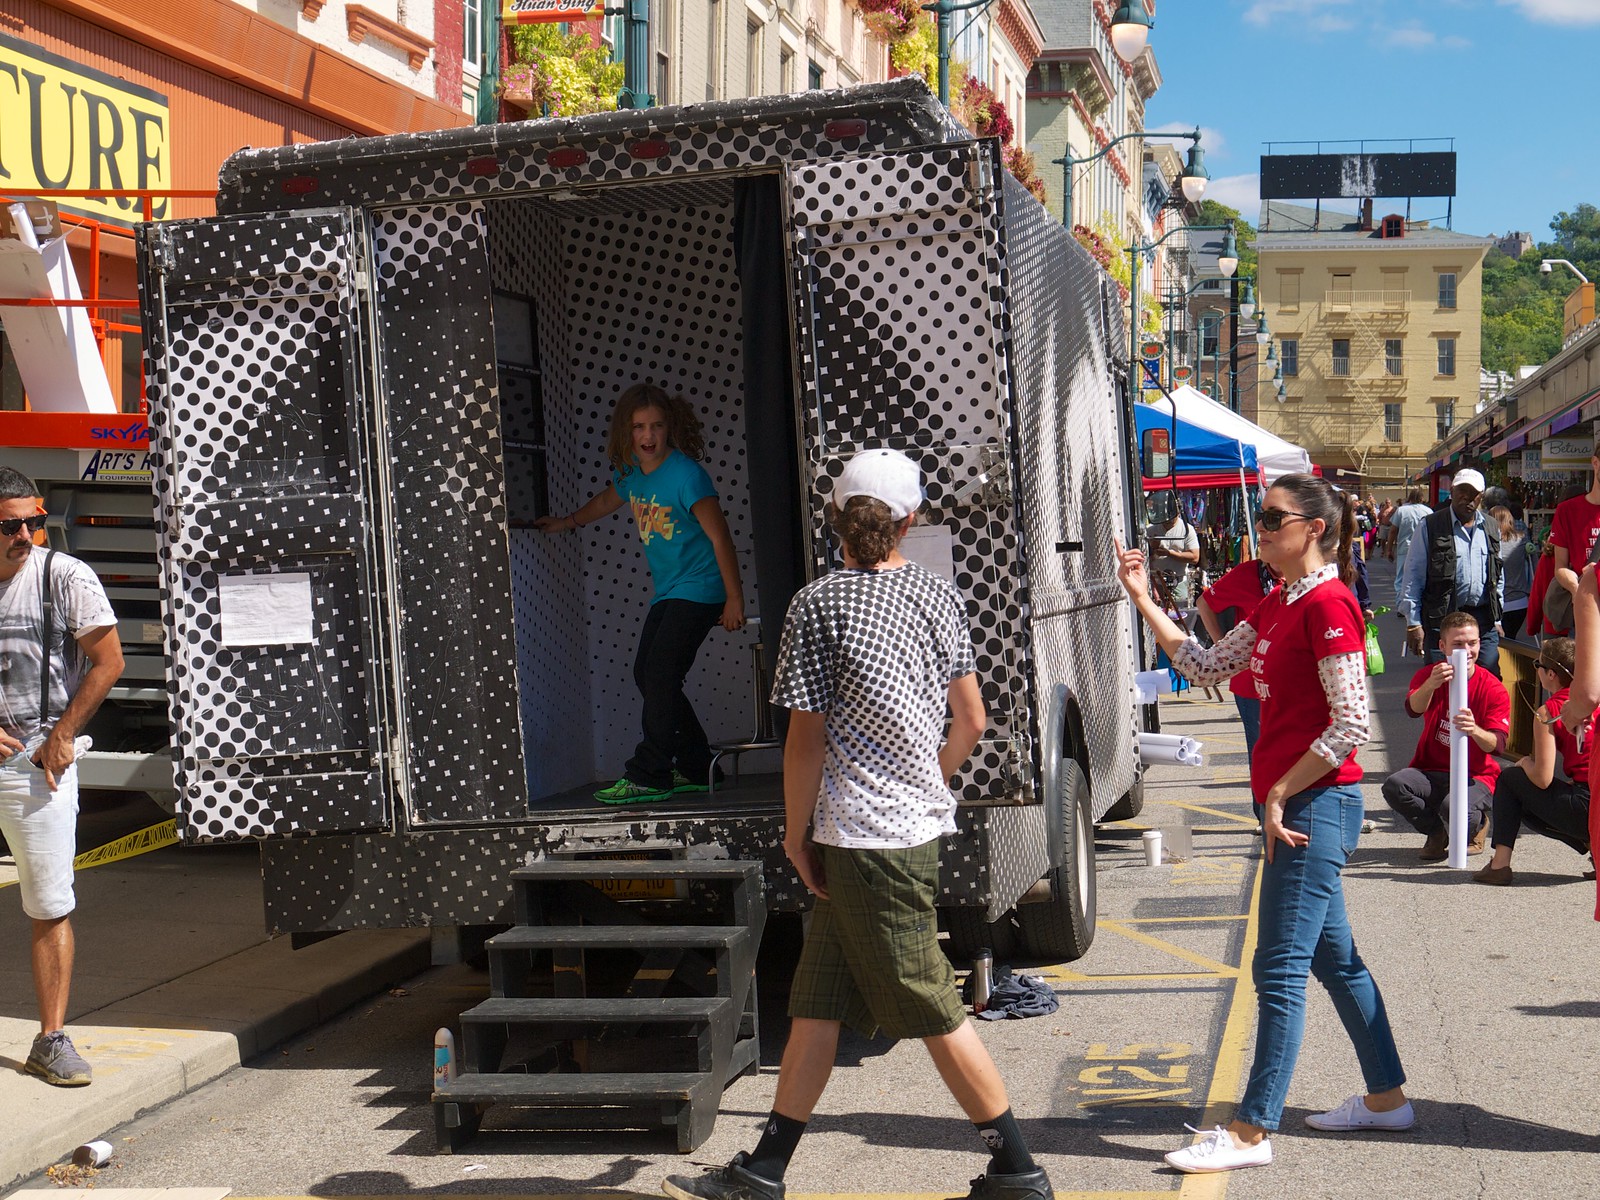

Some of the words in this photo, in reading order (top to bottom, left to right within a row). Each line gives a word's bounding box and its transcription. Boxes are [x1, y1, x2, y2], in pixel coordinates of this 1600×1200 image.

[511, 0, 556, 11] Huan
[559, 0, 596, 12] Ying
[81, 450, 136, 481] ART'S
